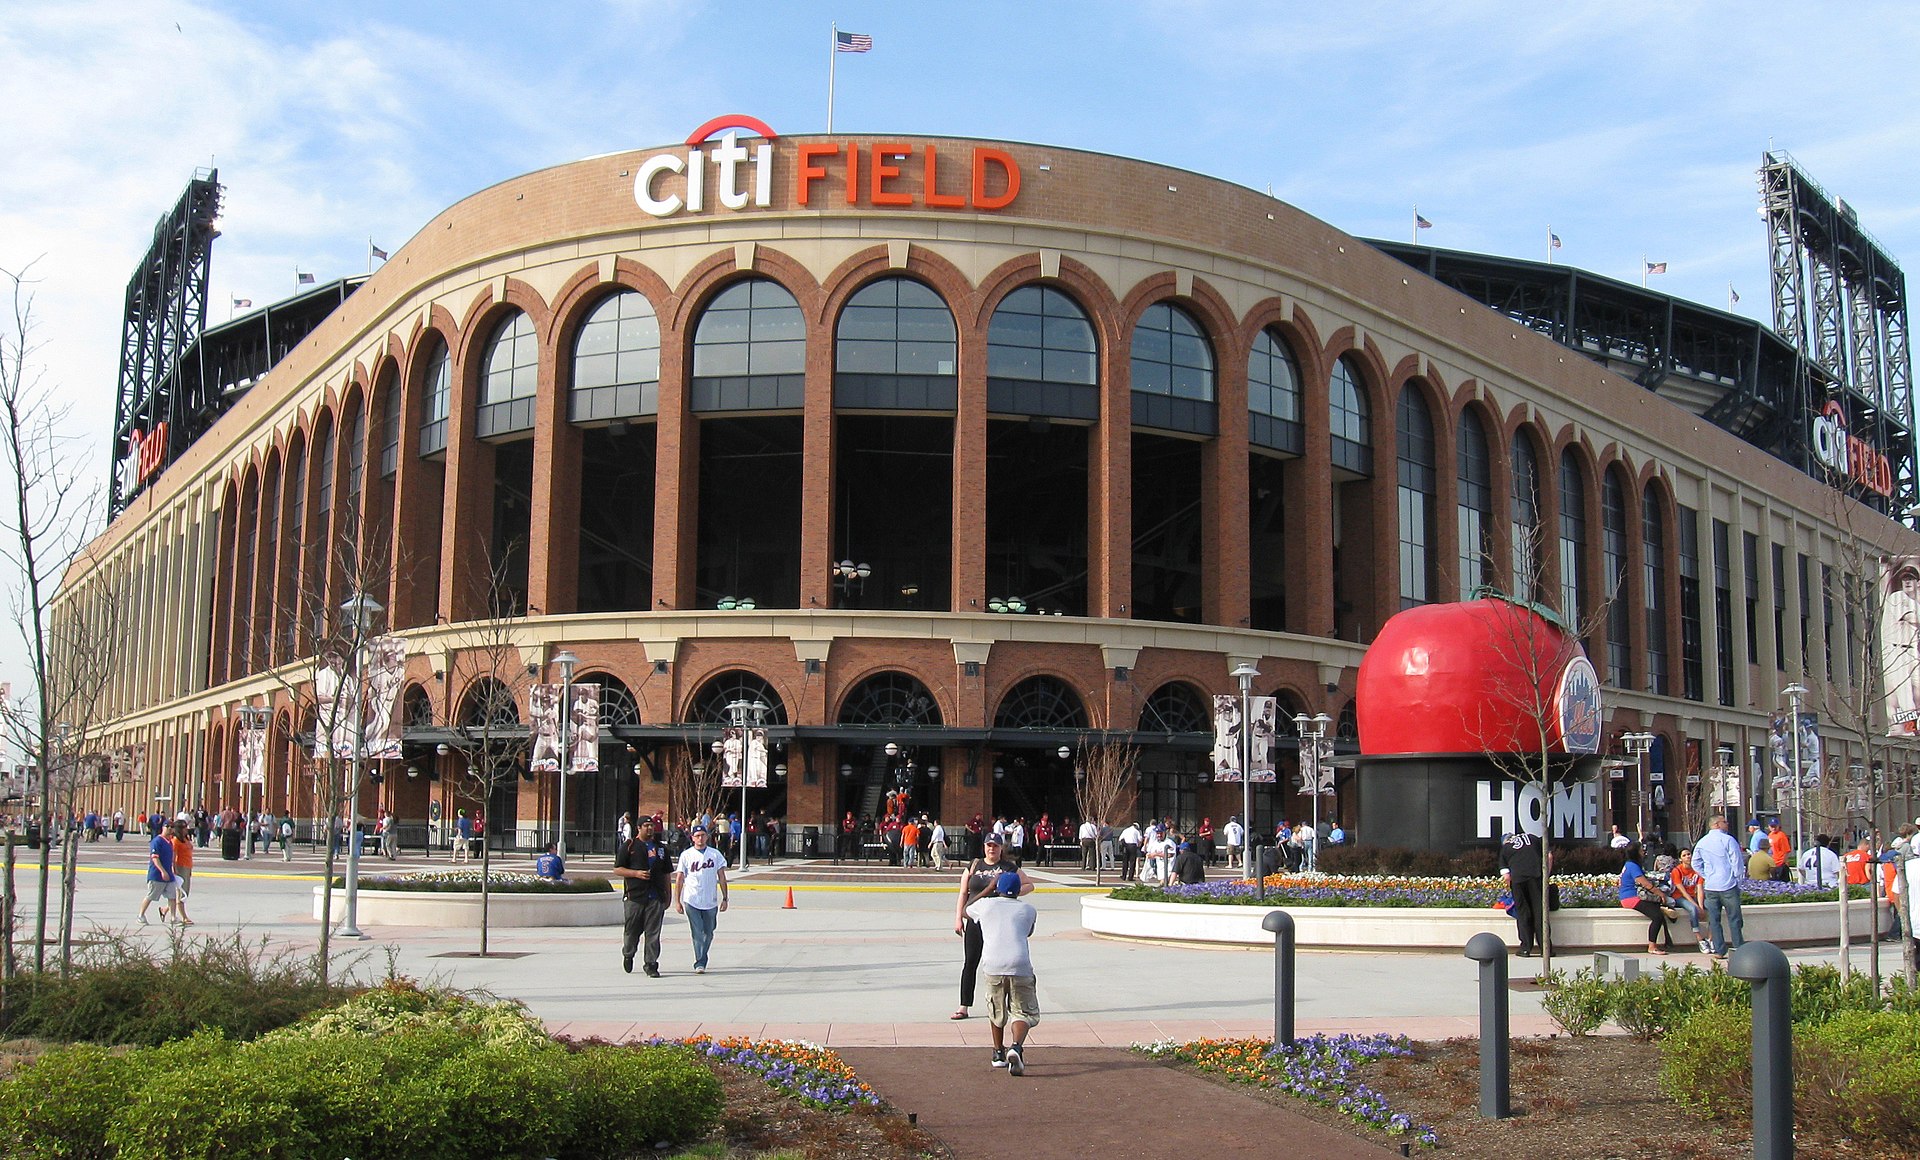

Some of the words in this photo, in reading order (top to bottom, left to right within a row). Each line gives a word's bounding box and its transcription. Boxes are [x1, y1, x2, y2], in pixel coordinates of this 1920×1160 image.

[633, 130, 773, 217] citi
[796, 142, 1021, 209] FIELD
[1476, 780, 1598, 838] HOME
[1512, 833, 1532, 850] 31
[690, 858, 715, 873] Mets
